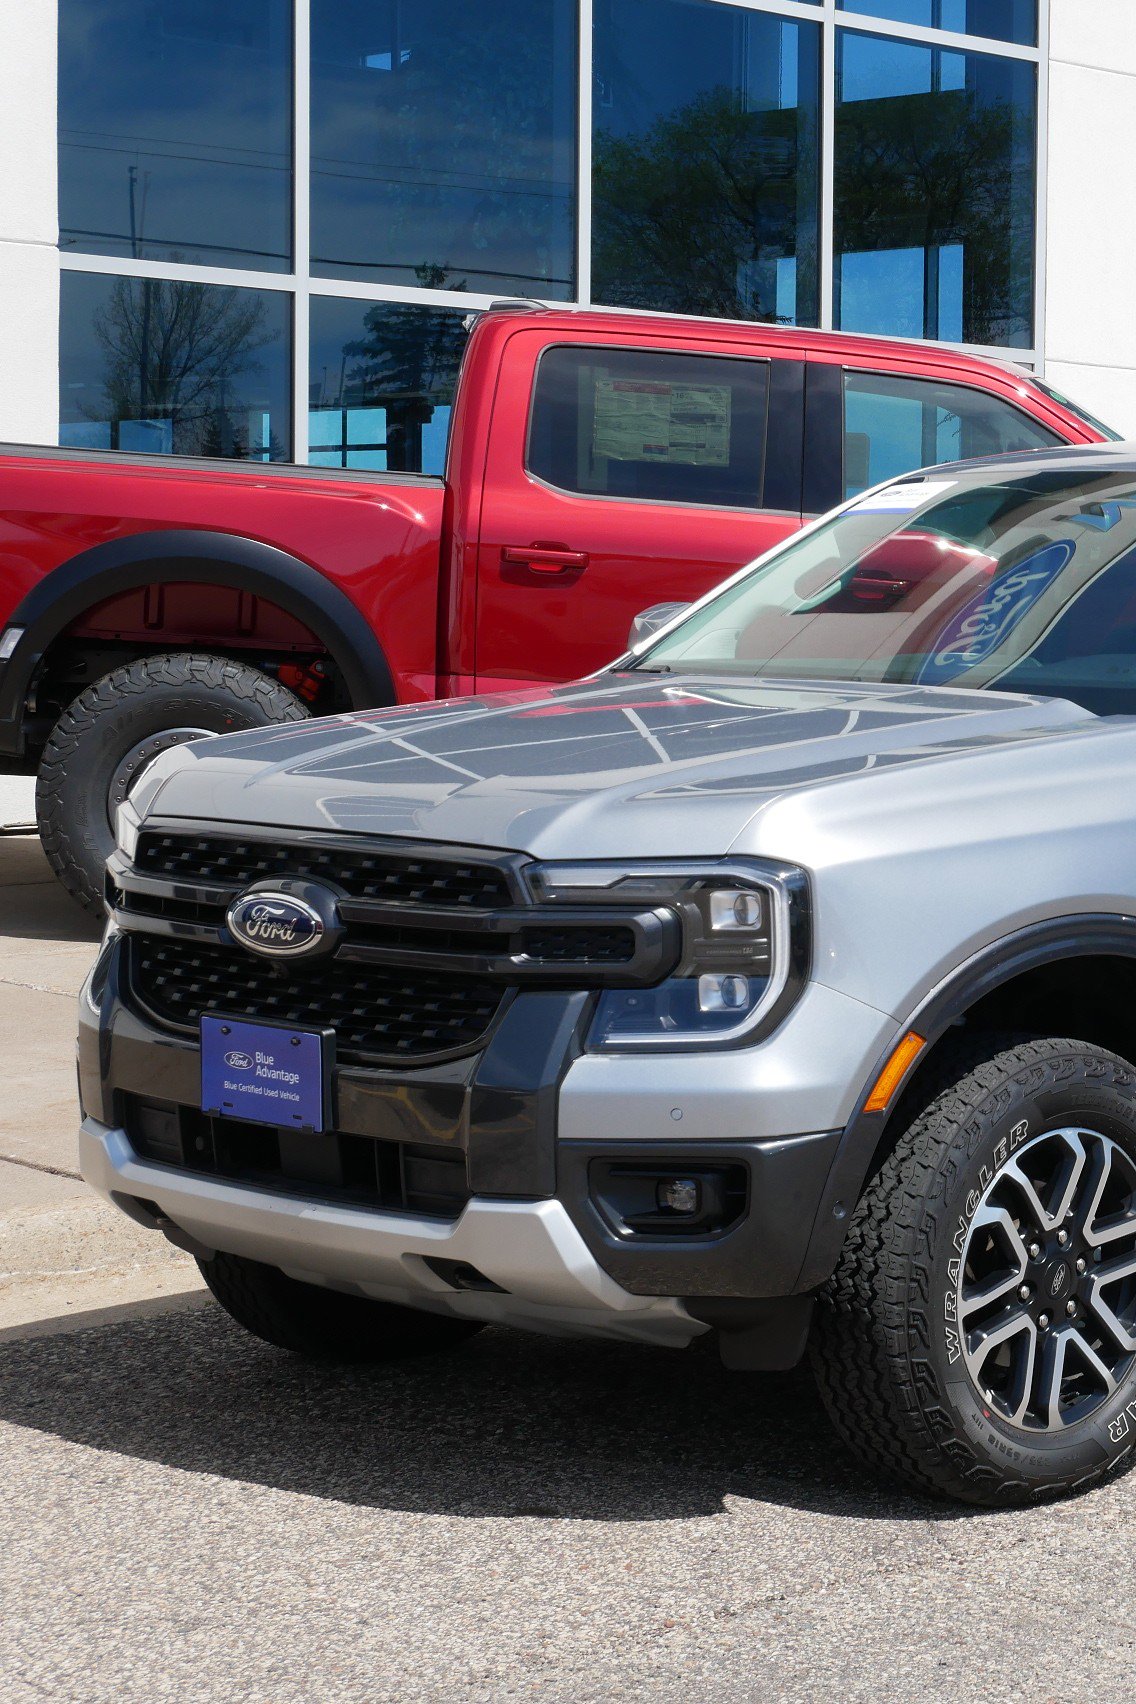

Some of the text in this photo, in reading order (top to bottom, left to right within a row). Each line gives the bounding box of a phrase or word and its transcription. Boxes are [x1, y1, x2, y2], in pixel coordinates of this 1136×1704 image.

[246, 904, 297, 942] Ford
[229, 1053, 249, 1067] Ford
[255, 1051, 274, 1065] Blue
[256, 1065, 300, 1085] Advantage
[224, 1080, 300, 1101] Blue Certified Used Vehicle
[944, 1119, 1029, 1364] WRANGLER
